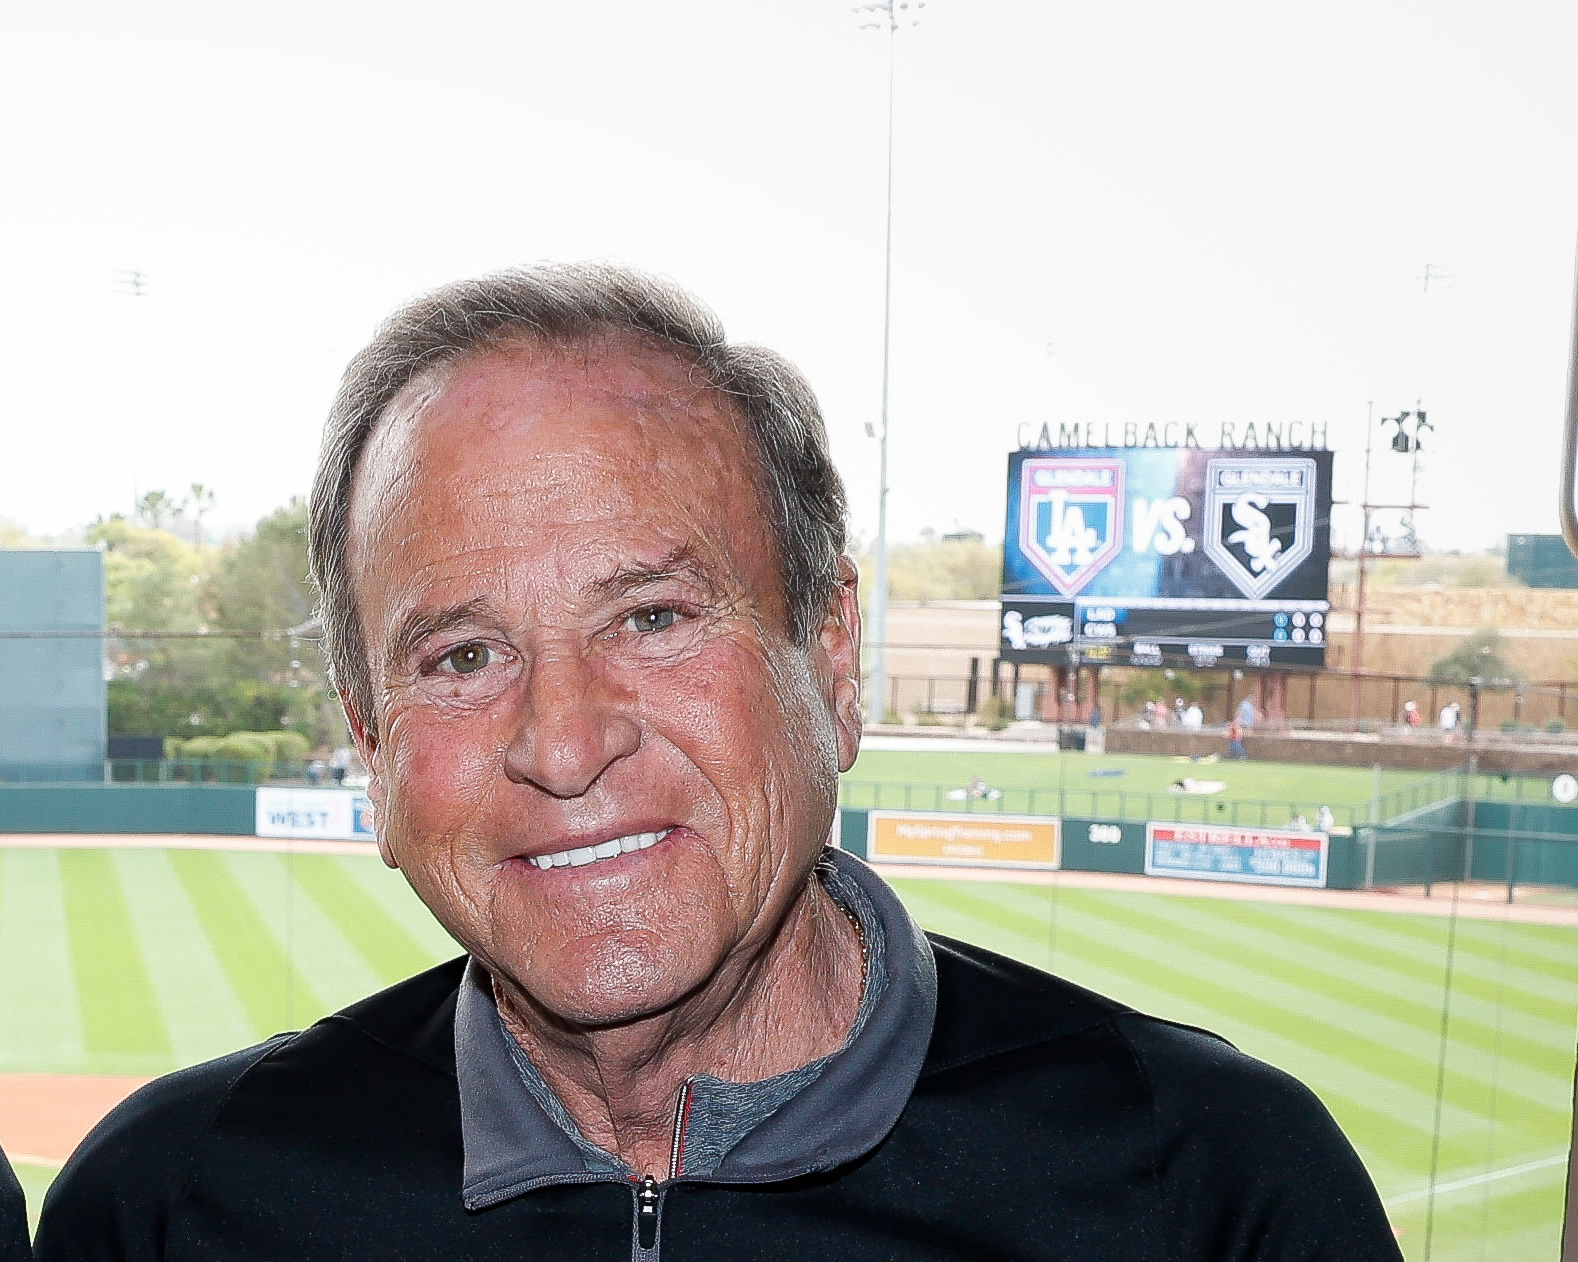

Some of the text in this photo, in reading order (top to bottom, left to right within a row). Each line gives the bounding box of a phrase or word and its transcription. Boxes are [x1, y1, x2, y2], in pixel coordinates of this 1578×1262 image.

[1017, 421, 1328, 448] CAMELBACK RANCH
[267, 810, 329, 828] WEST
